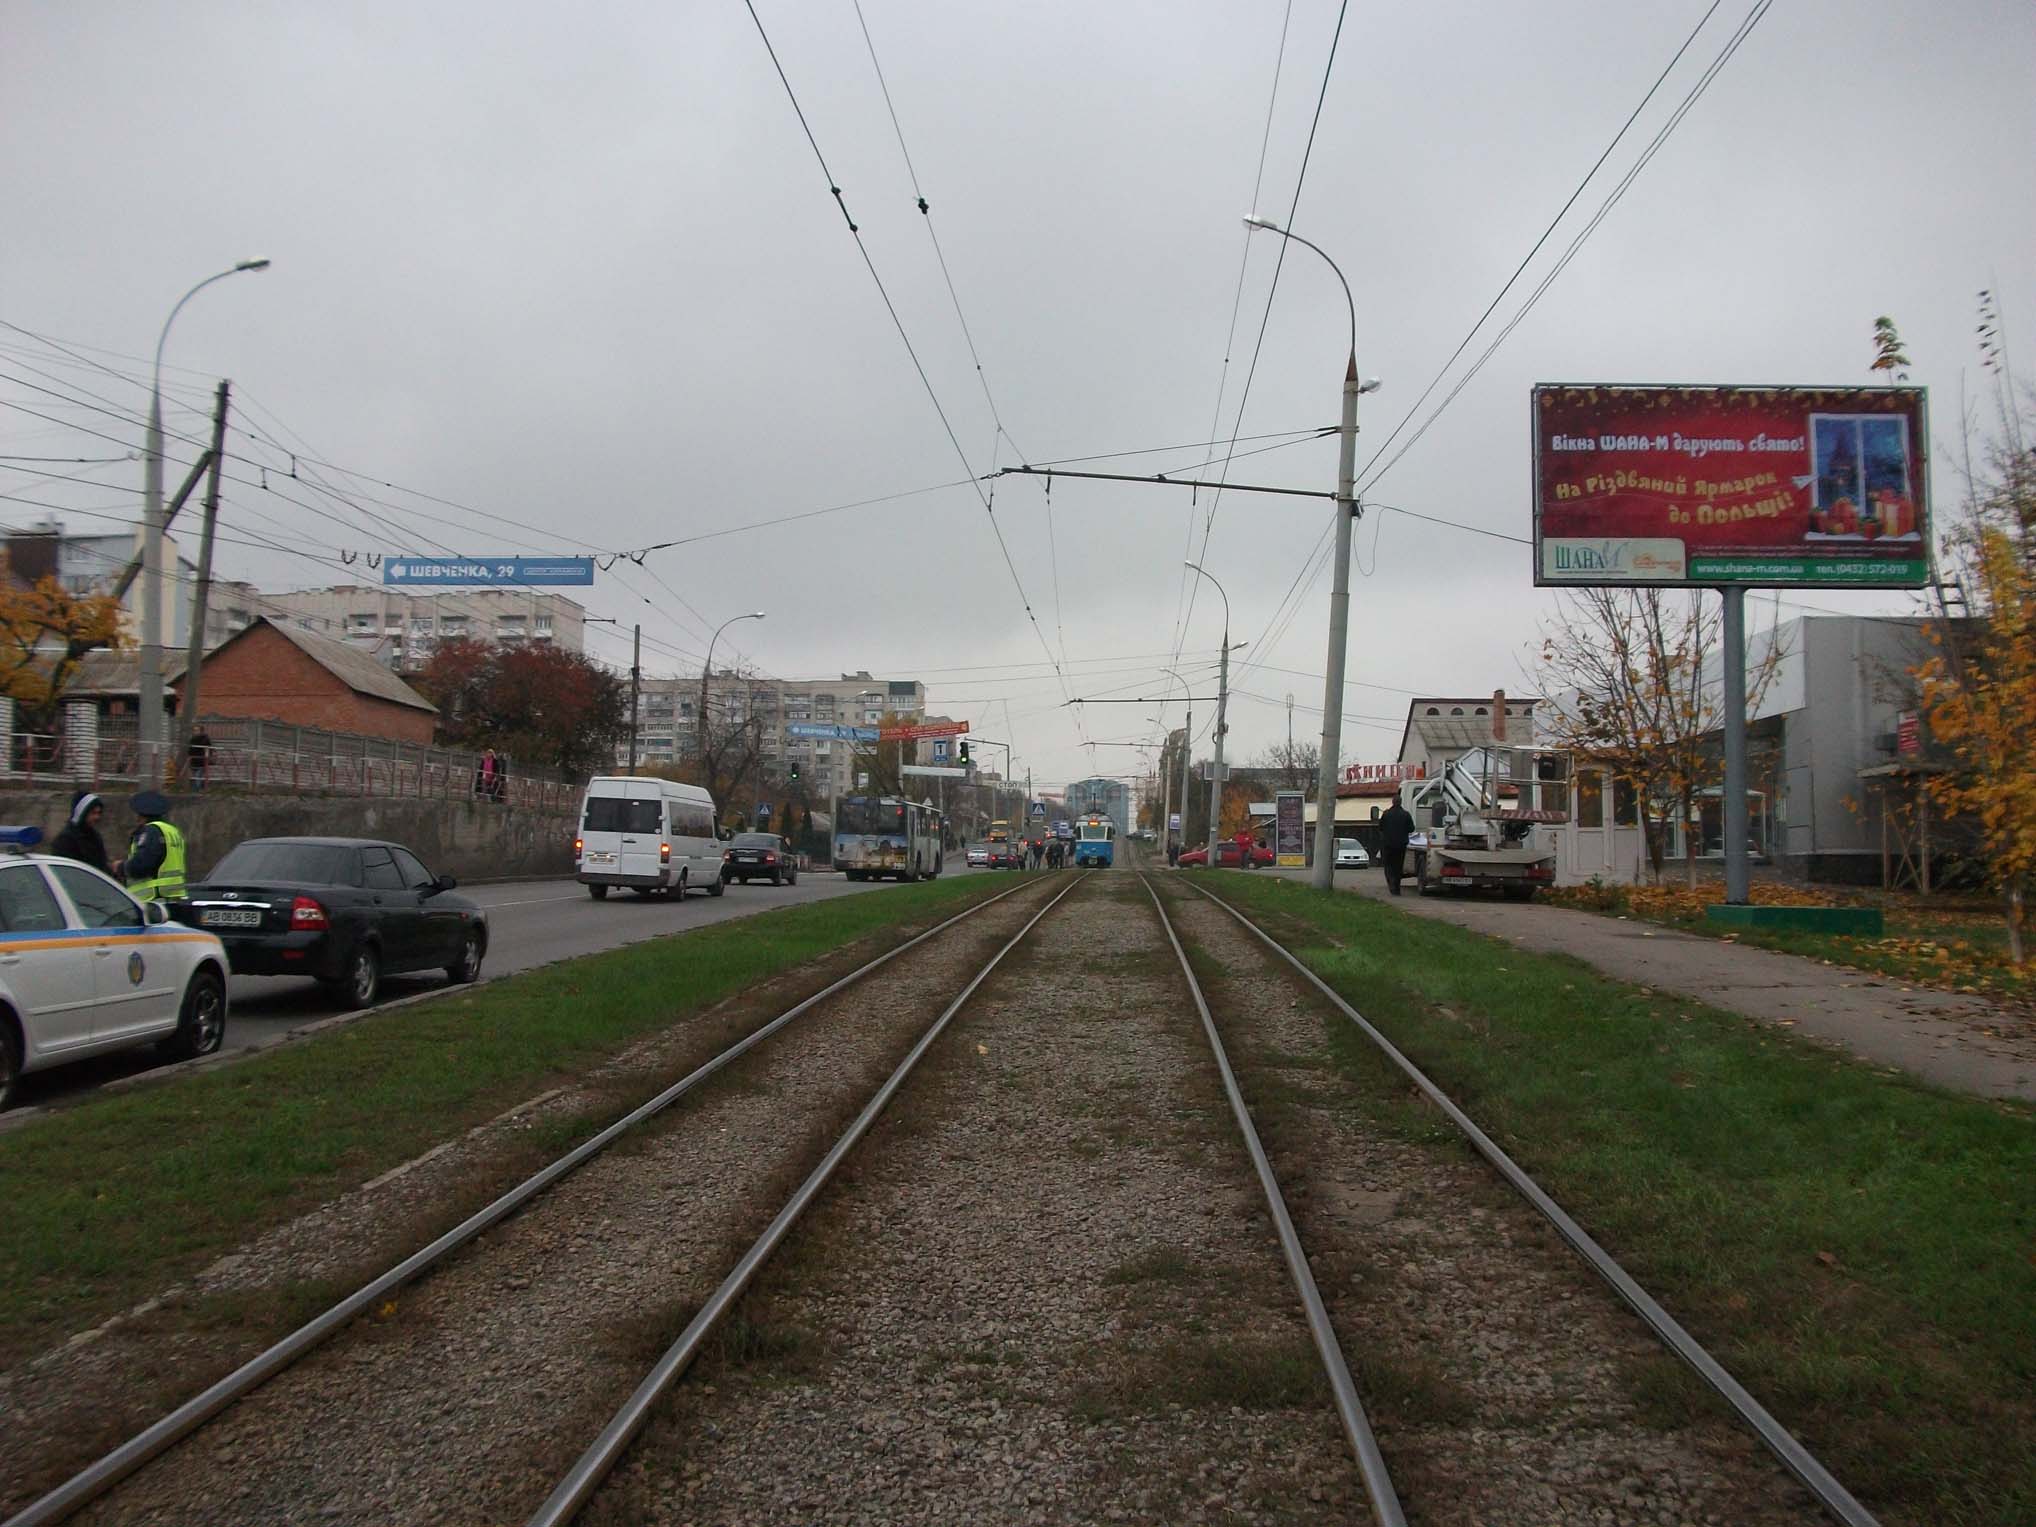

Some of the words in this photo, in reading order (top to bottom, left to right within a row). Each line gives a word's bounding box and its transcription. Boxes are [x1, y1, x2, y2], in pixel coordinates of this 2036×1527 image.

[1552, 434, 1595, 451] Вікна
[1600, 436, 1669, 451] ШАНА-М
[1673, 432, 1745, 458] дарують
[1749, 433, 1806, 452] свято!
[1556, 483, 1582, 500] На
[1586, 470, 1688, 496] Різдвяний
[1694, 472, 1778, 502] Ярмарок
[1668, 504, 1691, 524] до
[1696, 490, 1796, 525] Польщі!
[410, 564, 493, 579] ШЕВЧЕНКА,
[497, 565, 515, 578] 29
